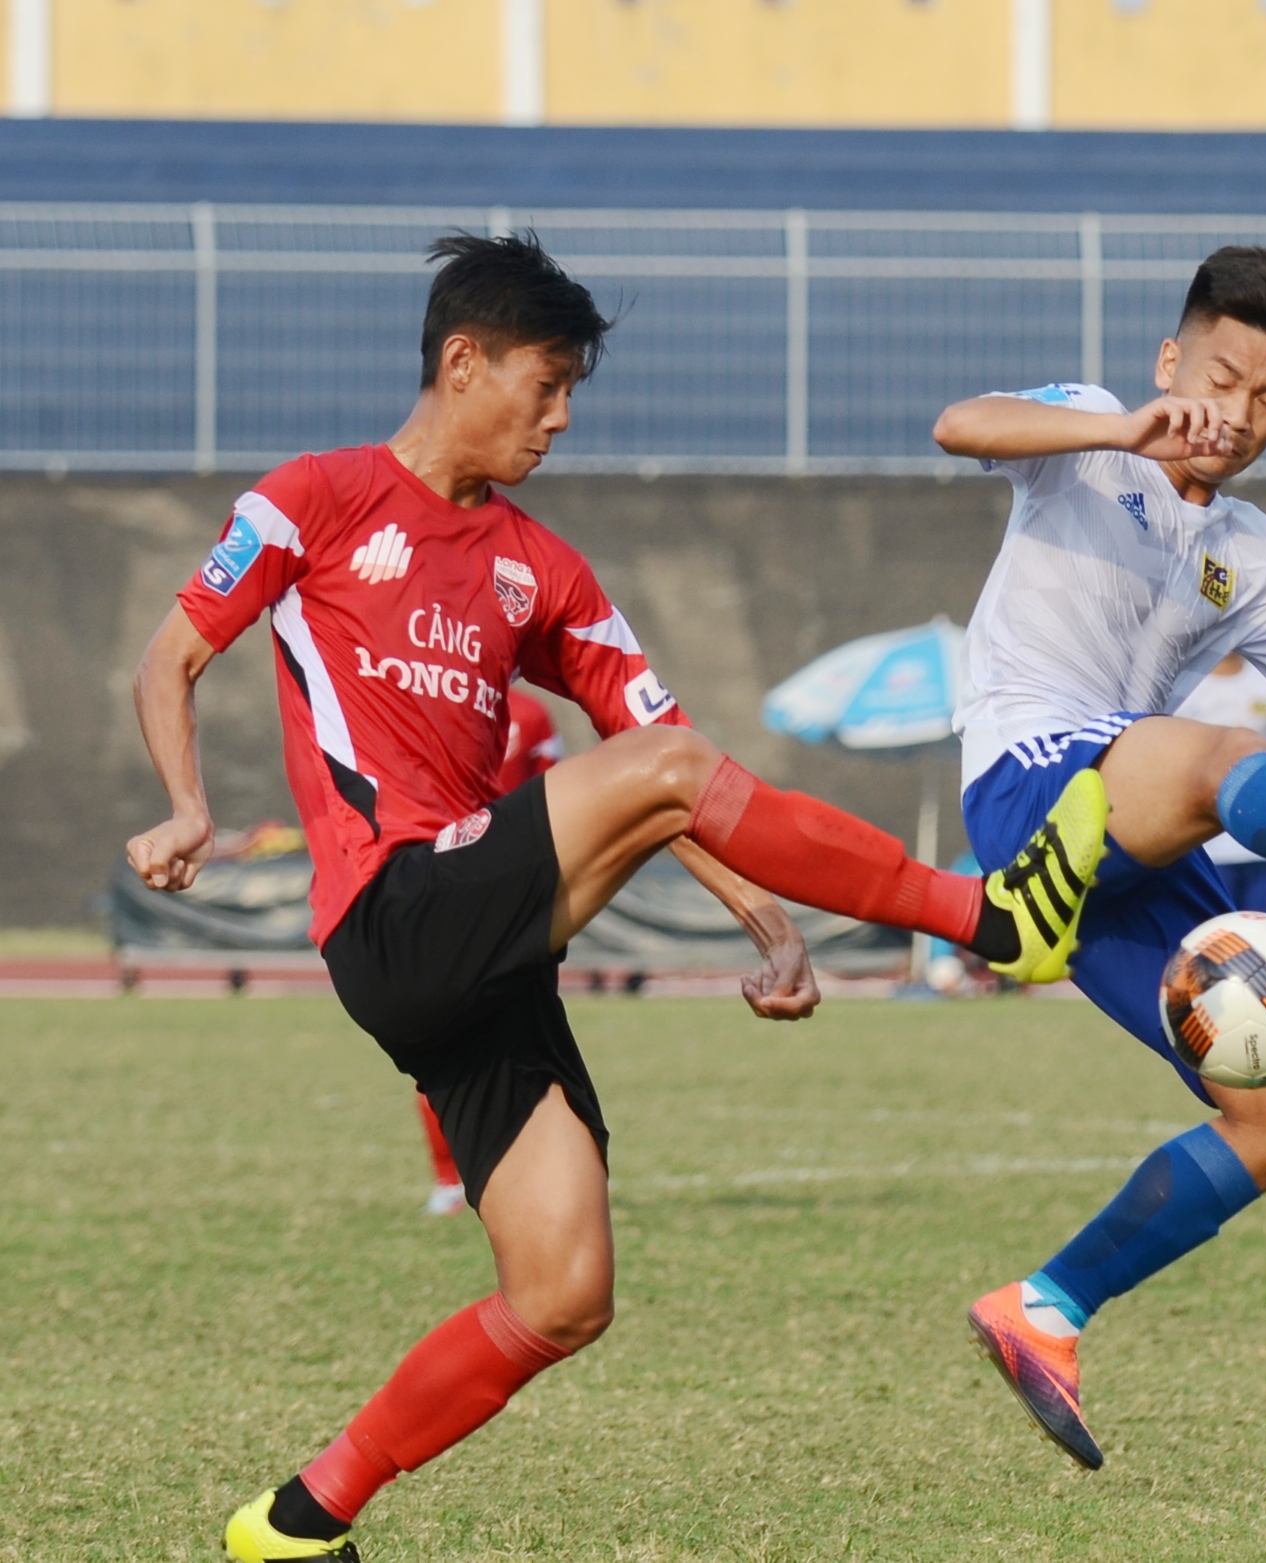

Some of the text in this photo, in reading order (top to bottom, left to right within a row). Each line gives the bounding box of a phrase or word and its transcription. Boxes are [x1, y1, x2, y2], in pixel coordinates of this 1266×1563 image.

[203, 559, 227, 585] LS
[408, 602, 482, 663] CẢNG
[354, 646, 470, 704] LONG
[1249, 1034, 1260, 1070] Spectro
